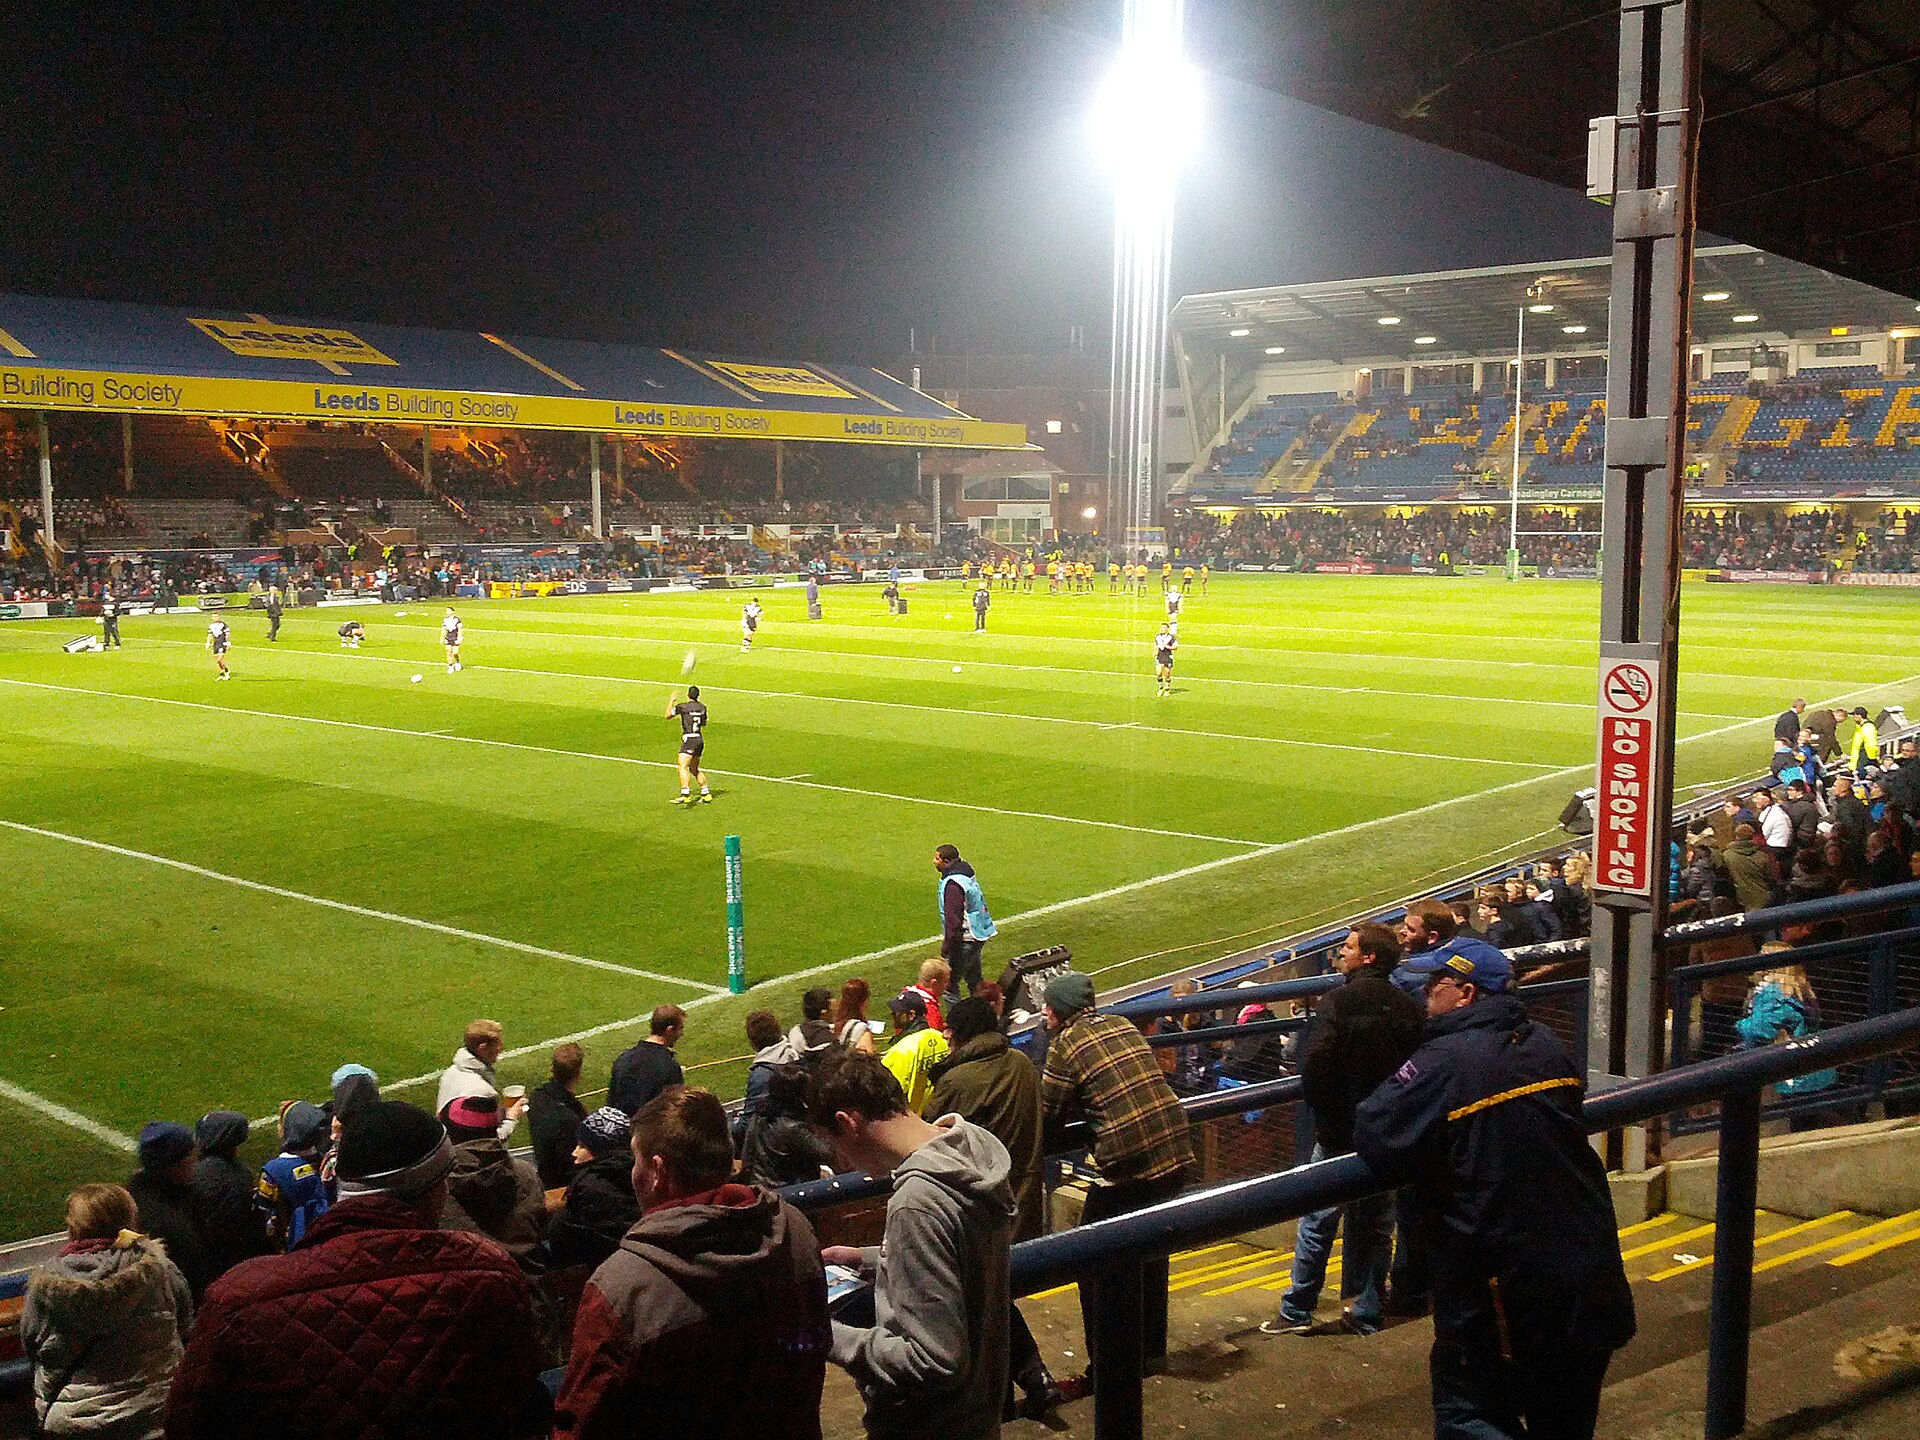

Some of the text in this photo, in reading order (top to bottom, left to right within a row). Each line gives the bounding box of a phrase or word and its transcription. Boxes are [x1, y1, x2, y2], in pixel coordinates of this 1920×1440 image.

[204, 324, 365, 348] Leeds
[3, 372, 183, 407] Building Society
[314, 388, 519, 421] Leeds Building Society
[615, 406, 771, 434] Leeds Building Society
[843, 418, 965, 441] Leeds Building Society
[1611, 720, 1641, 755] NO
[1608, 762, 1640, 885] SMOKING
